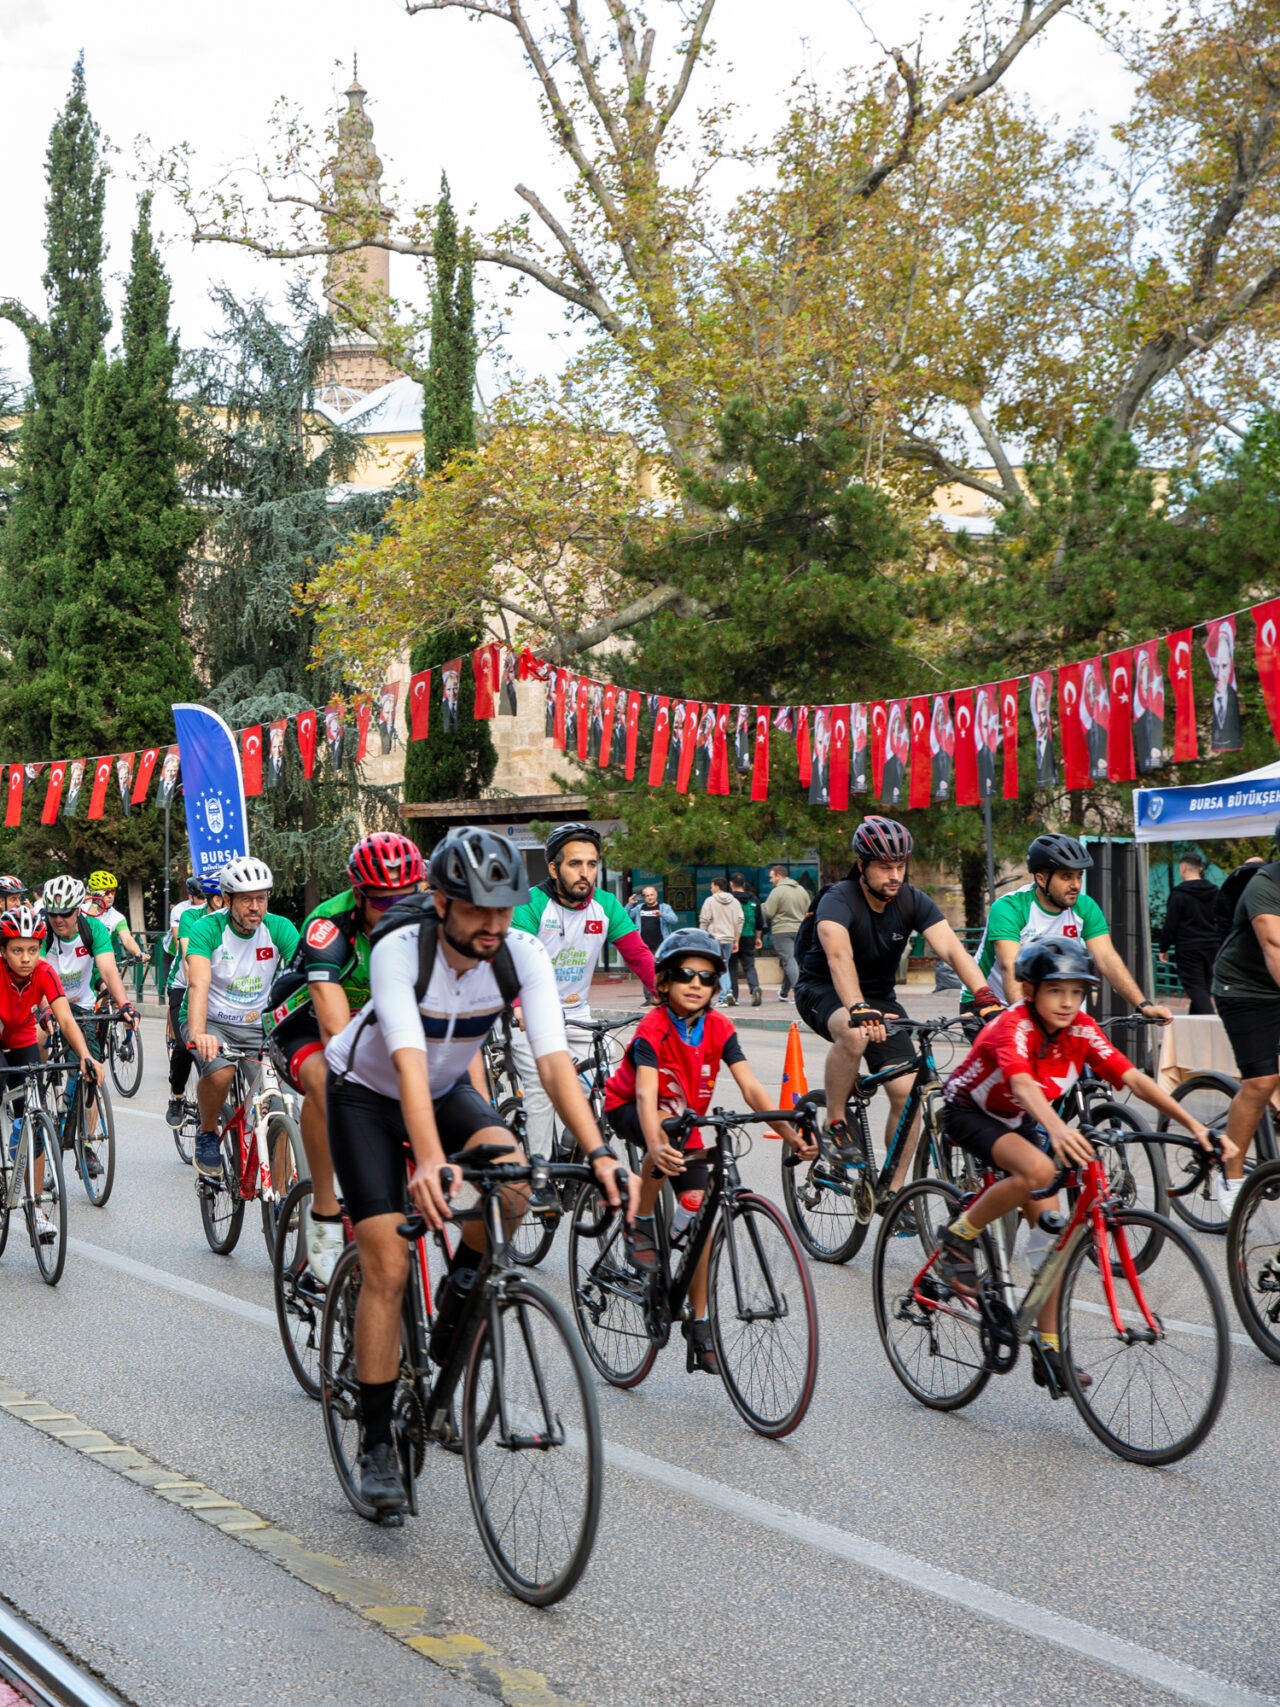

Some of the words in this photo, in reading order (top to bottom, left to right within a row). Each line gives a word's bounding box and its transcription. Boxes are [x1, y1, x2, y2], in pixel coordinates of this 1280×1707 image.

[1189, 796, 1223, 811] BURSA
[200, 849, 239, 864] BURSA
[217, 1011, 244, 1022] Rotary
